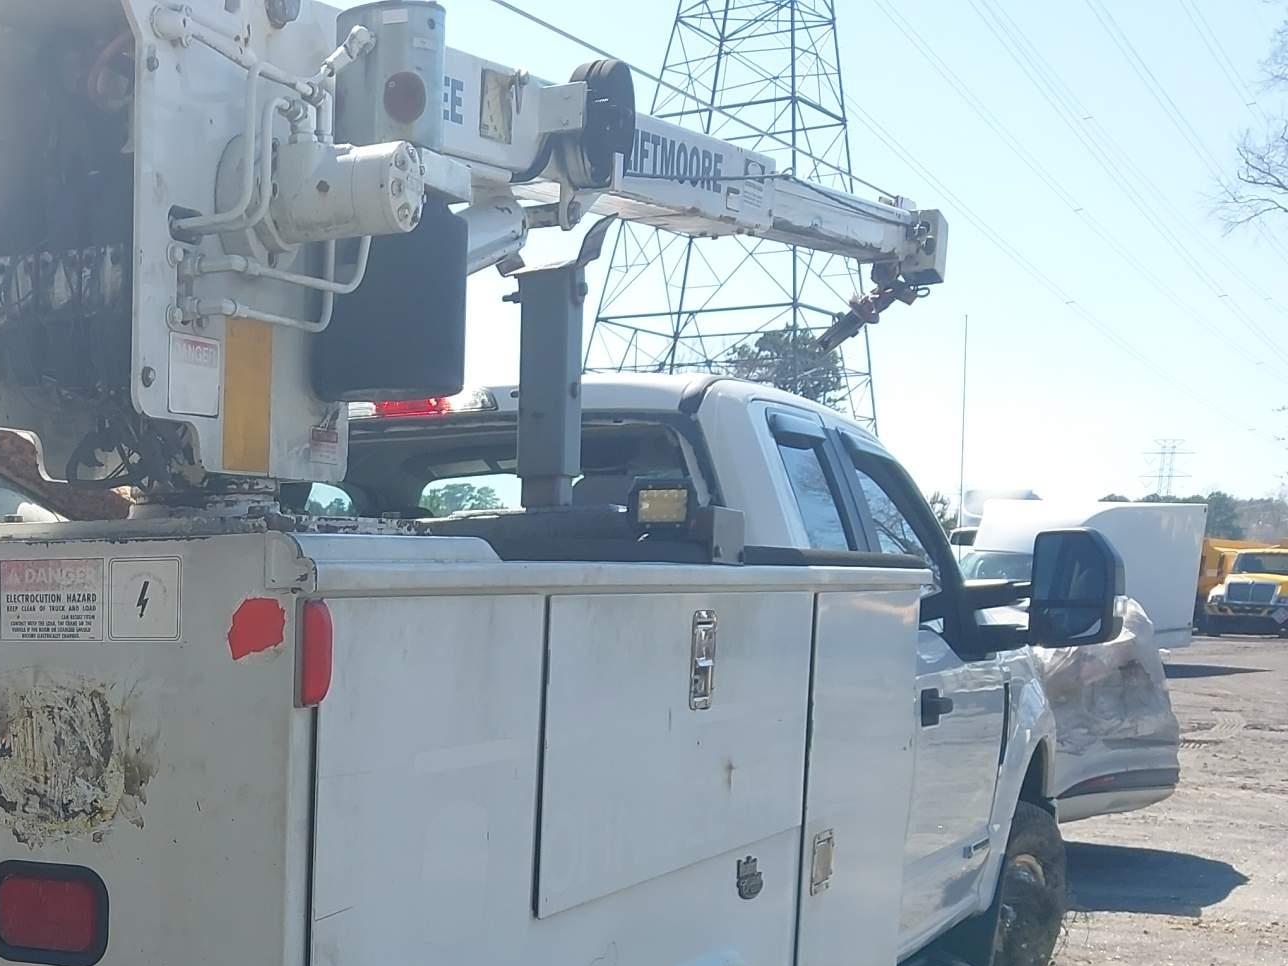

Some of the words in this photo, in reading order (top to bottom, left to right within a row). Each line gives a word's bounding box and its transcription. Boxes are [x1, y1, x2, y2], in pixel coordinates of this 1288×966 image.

[6, 593, 62, 604] ELECTROCUTION
[66, 592, 97, 604] HAZARD
[6, 605, 19, 613] KEEP
[21, 605, 36, 613] CLEAR
[39, 605, 46, 613] OF
[49, 605, 66, 613] TRUCK
[68, 605, 80, 613] AND
[82, 604, 97, 612] LOAD
